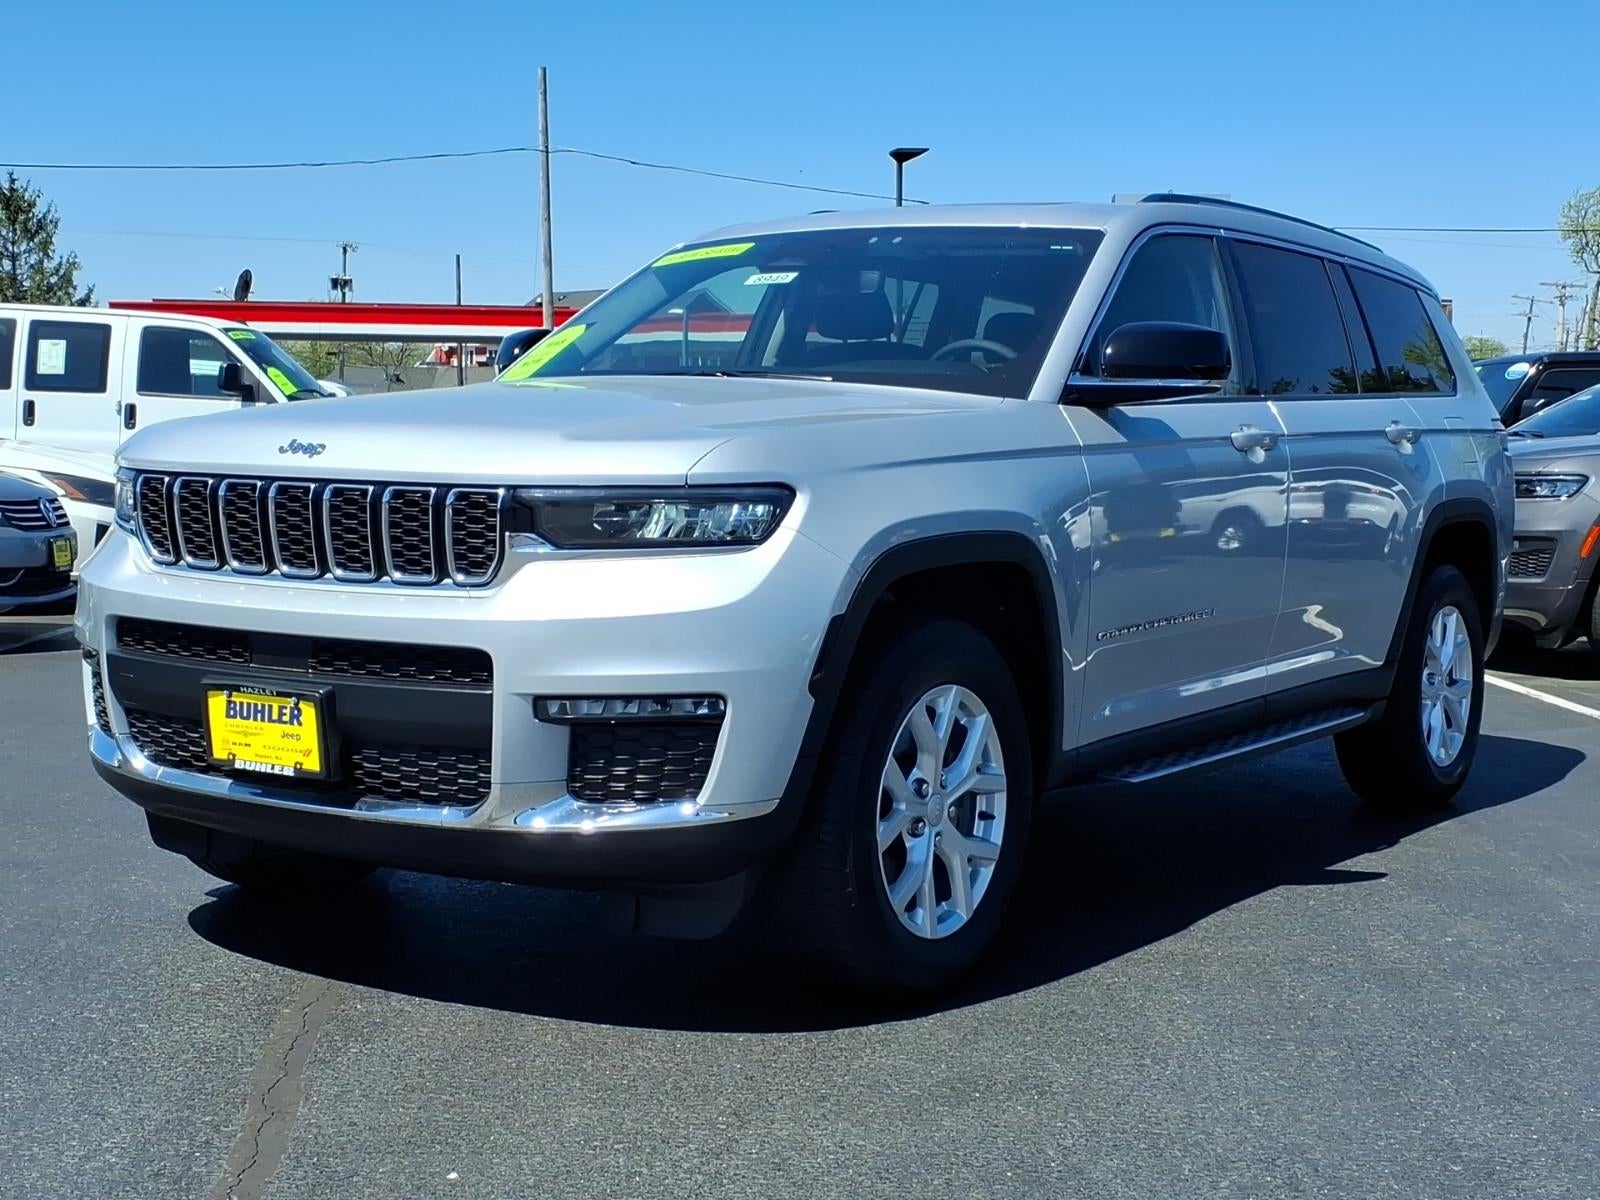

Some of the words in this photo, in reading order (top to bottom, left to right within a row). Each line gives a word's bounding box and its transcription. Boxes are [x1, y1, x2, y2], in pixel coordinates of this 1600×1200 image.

[278, 438, 327, 459] Jeep
[239, 686, 277, 697] HAZLET
[225, 700, 303, 727] BUHLER
[280, 730, 302, 742] Jeep
[234, 759, 295, 777] BUHLER
